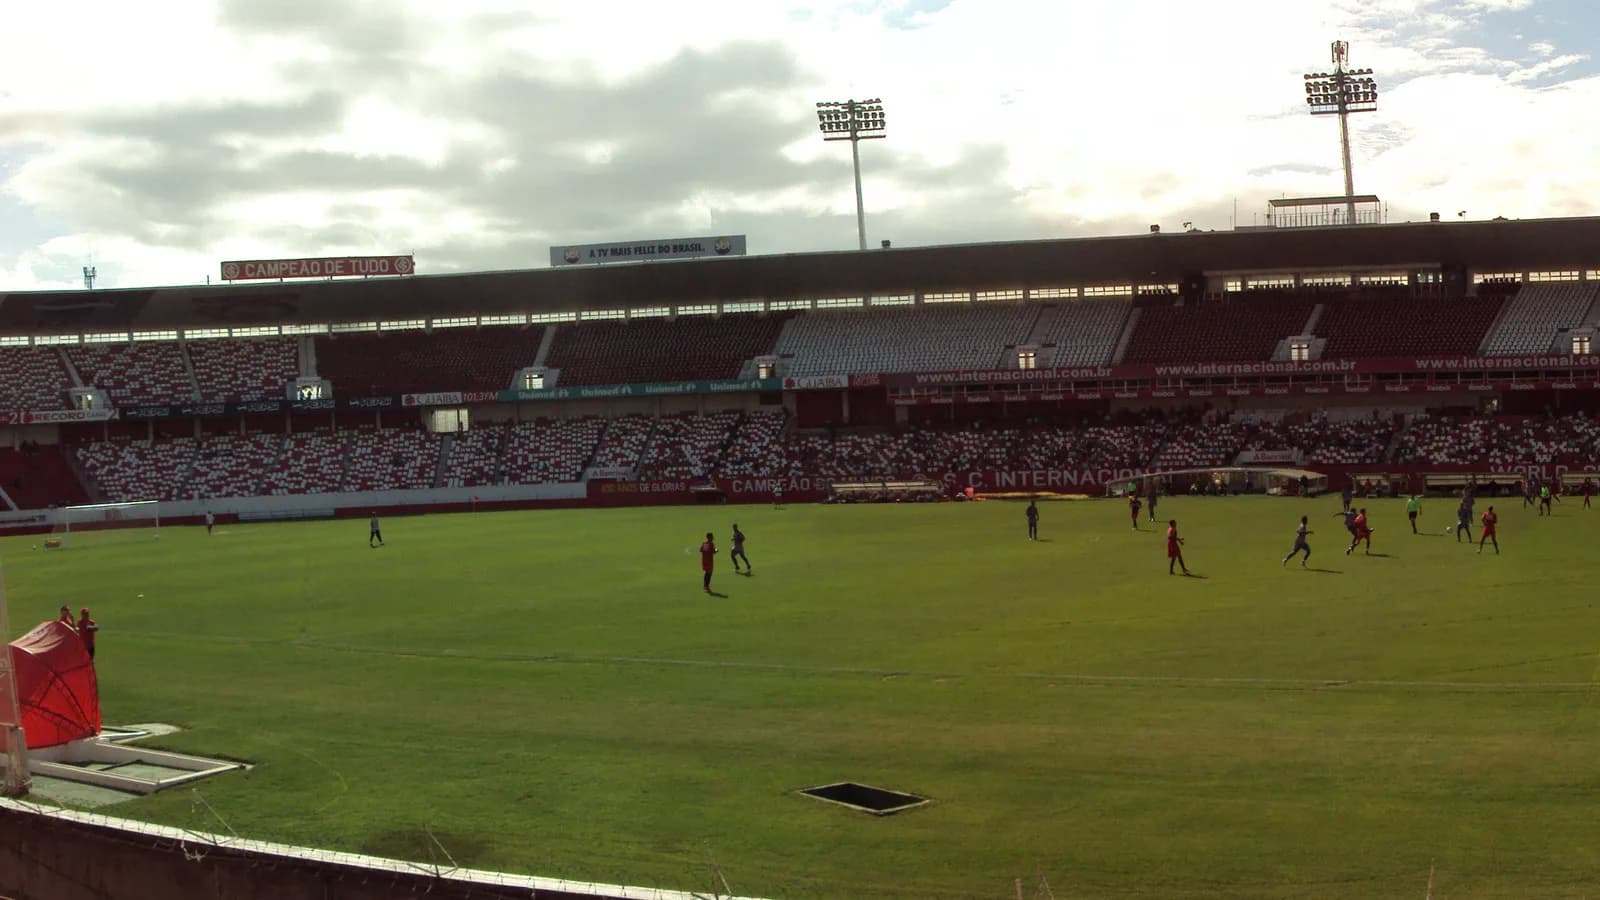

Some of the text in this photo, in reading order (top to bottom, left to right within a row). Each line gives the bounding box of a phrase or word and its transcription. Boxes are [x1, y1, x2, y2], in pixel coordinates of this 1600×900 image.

[598, 249, 608, 257] TV
[610, 247, 632, 256] MAIS
[634, 246, 655, 255] FELIZ
[658, 245, 670, 254] DO
[325, 260, 345, 274] DE
[349, 259, 389, 273] TUDO
[915, 367, 1113, 384] www.internacional.com.br
[1155, 359, 1357, 376] www.internacional.com.br
